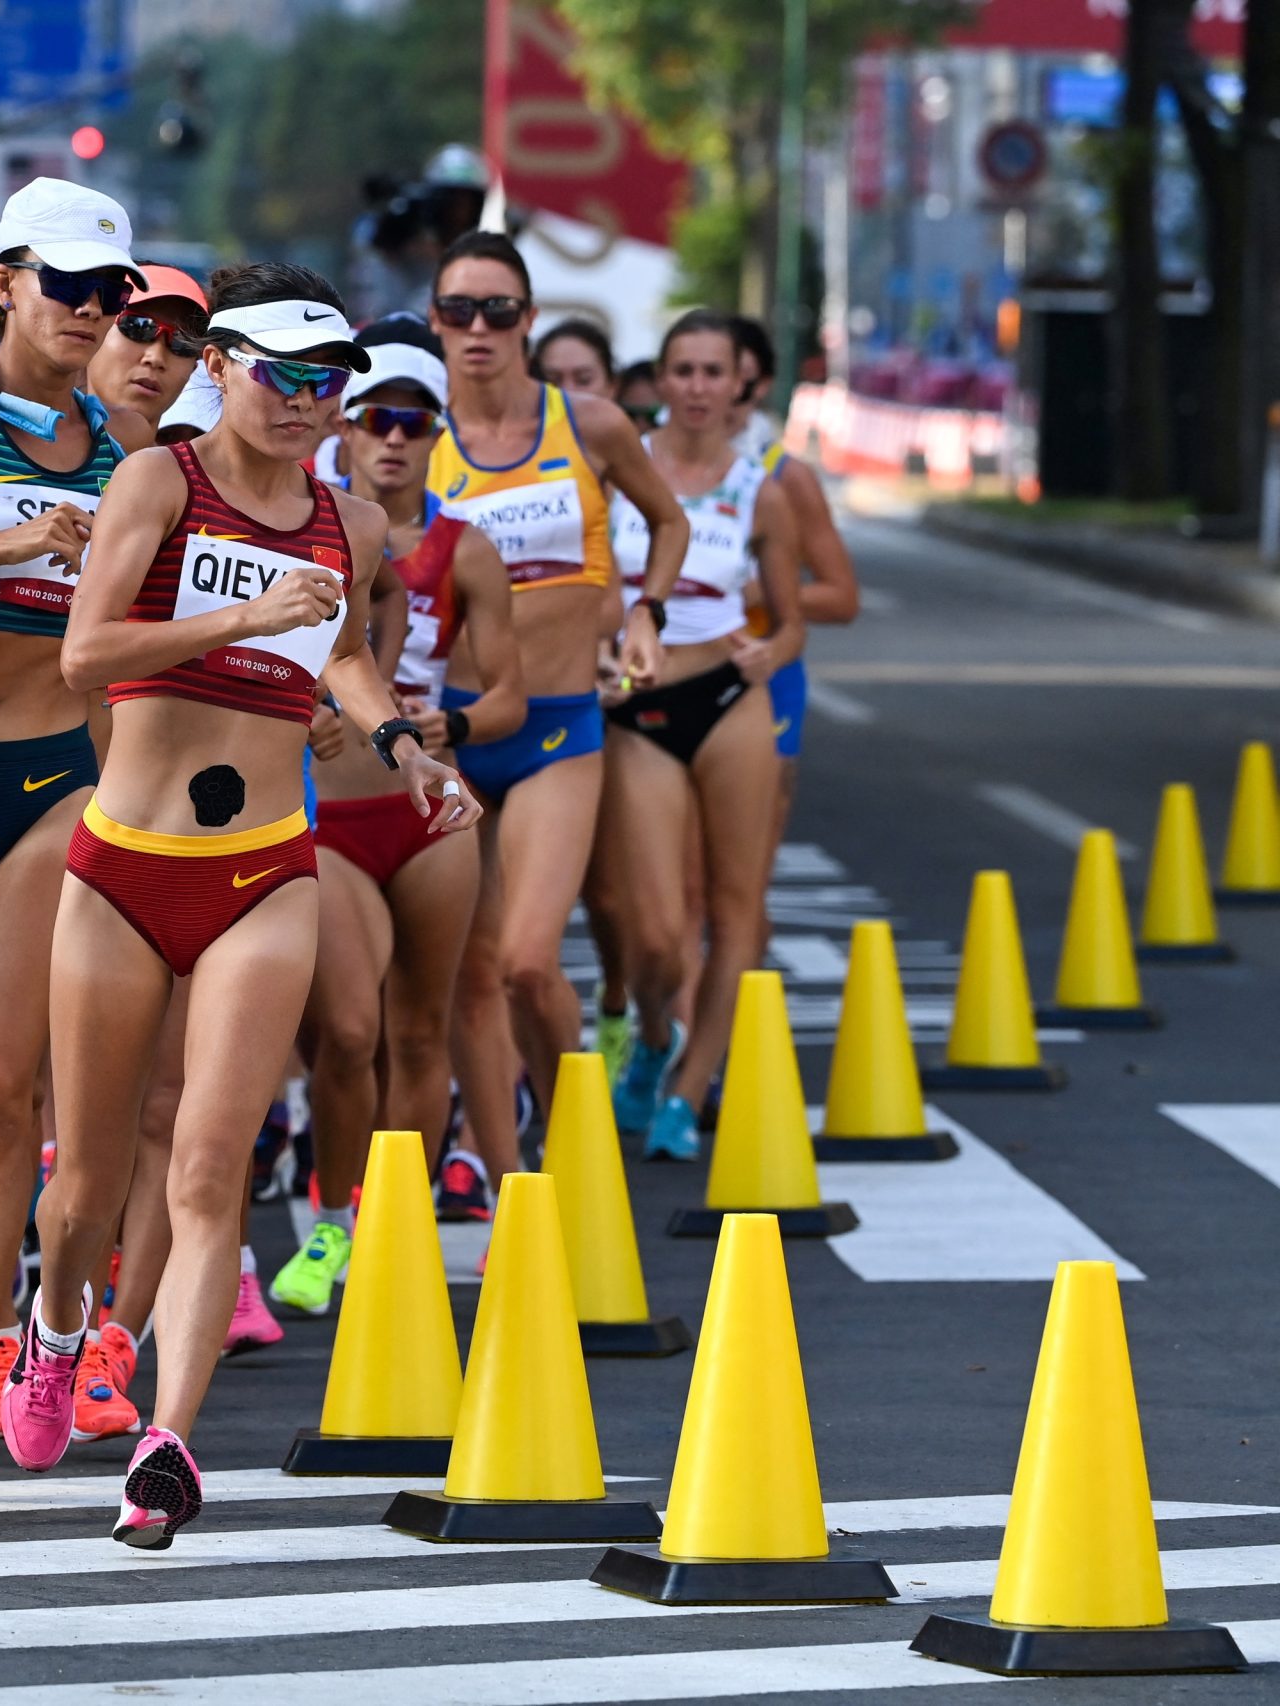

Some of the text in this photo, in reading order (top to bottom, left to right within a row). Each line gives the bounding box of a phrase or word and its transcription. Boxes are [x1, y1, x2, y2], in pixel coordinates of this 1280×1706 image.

[15, 586, 63, 603] TOKYO 2020
[225, 655, 270, 673] TOKYO 2020
